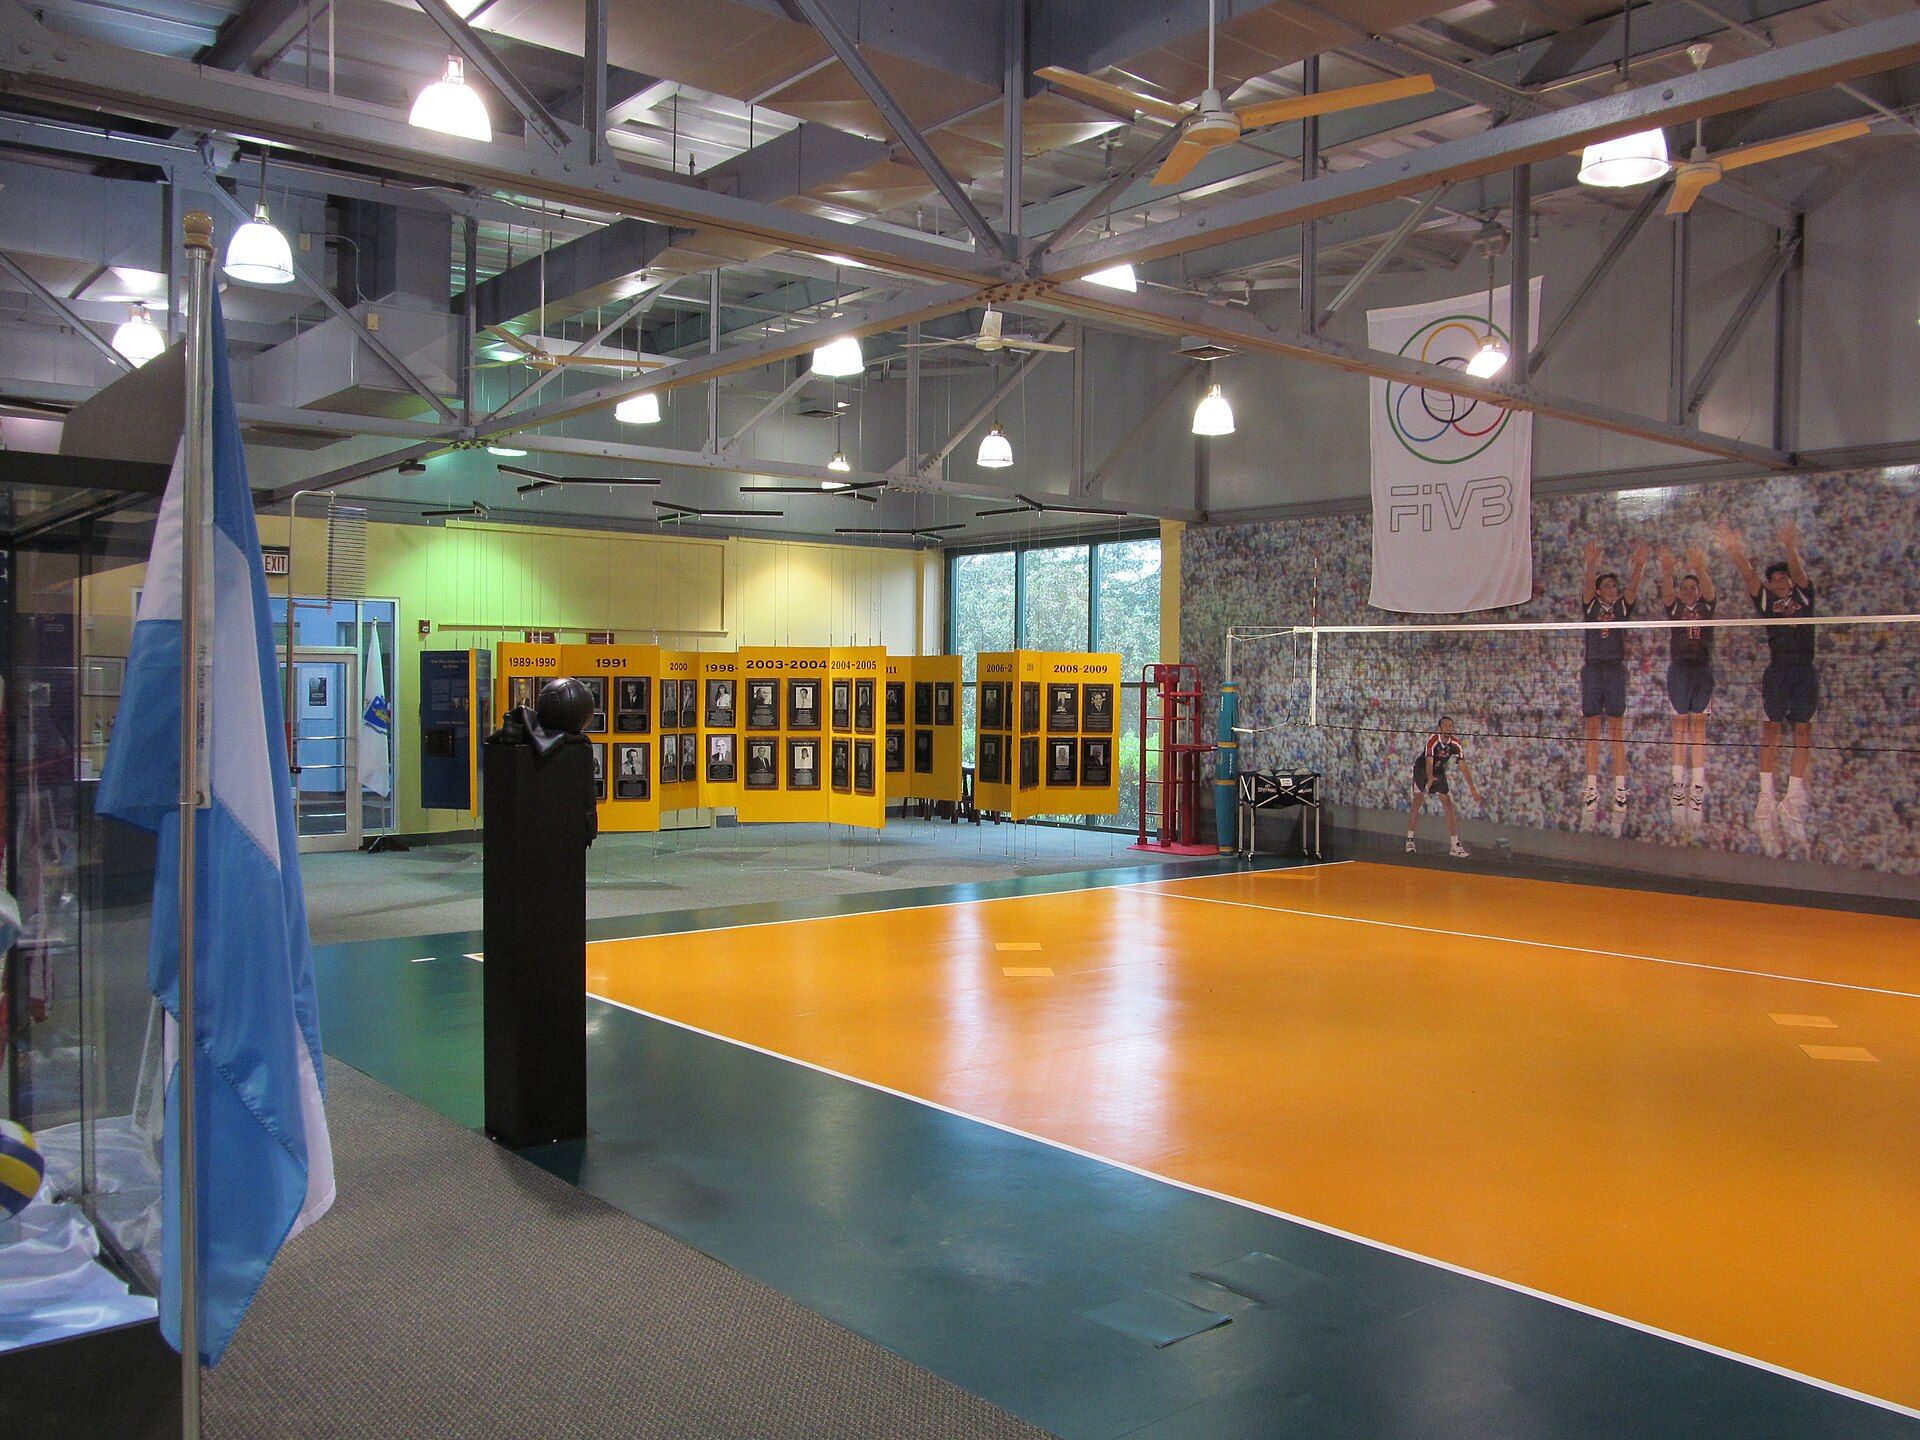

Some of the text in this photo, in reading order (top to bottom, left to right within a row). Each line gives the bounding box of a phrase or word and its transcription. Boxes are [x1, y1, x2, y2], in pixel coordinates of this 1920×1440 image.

[264, 555, 286, 571] EXIT
[509, 657, 557, 667] 1989-1990
[595, 658, 627, 668] 1991
[669, 662, 688, 671] 2000
[745, 660, 828, 670] 2003-2004
[831, 660, 877, 670] 2004-2005
[1053, 664, 1108, 674] 2008-2009
